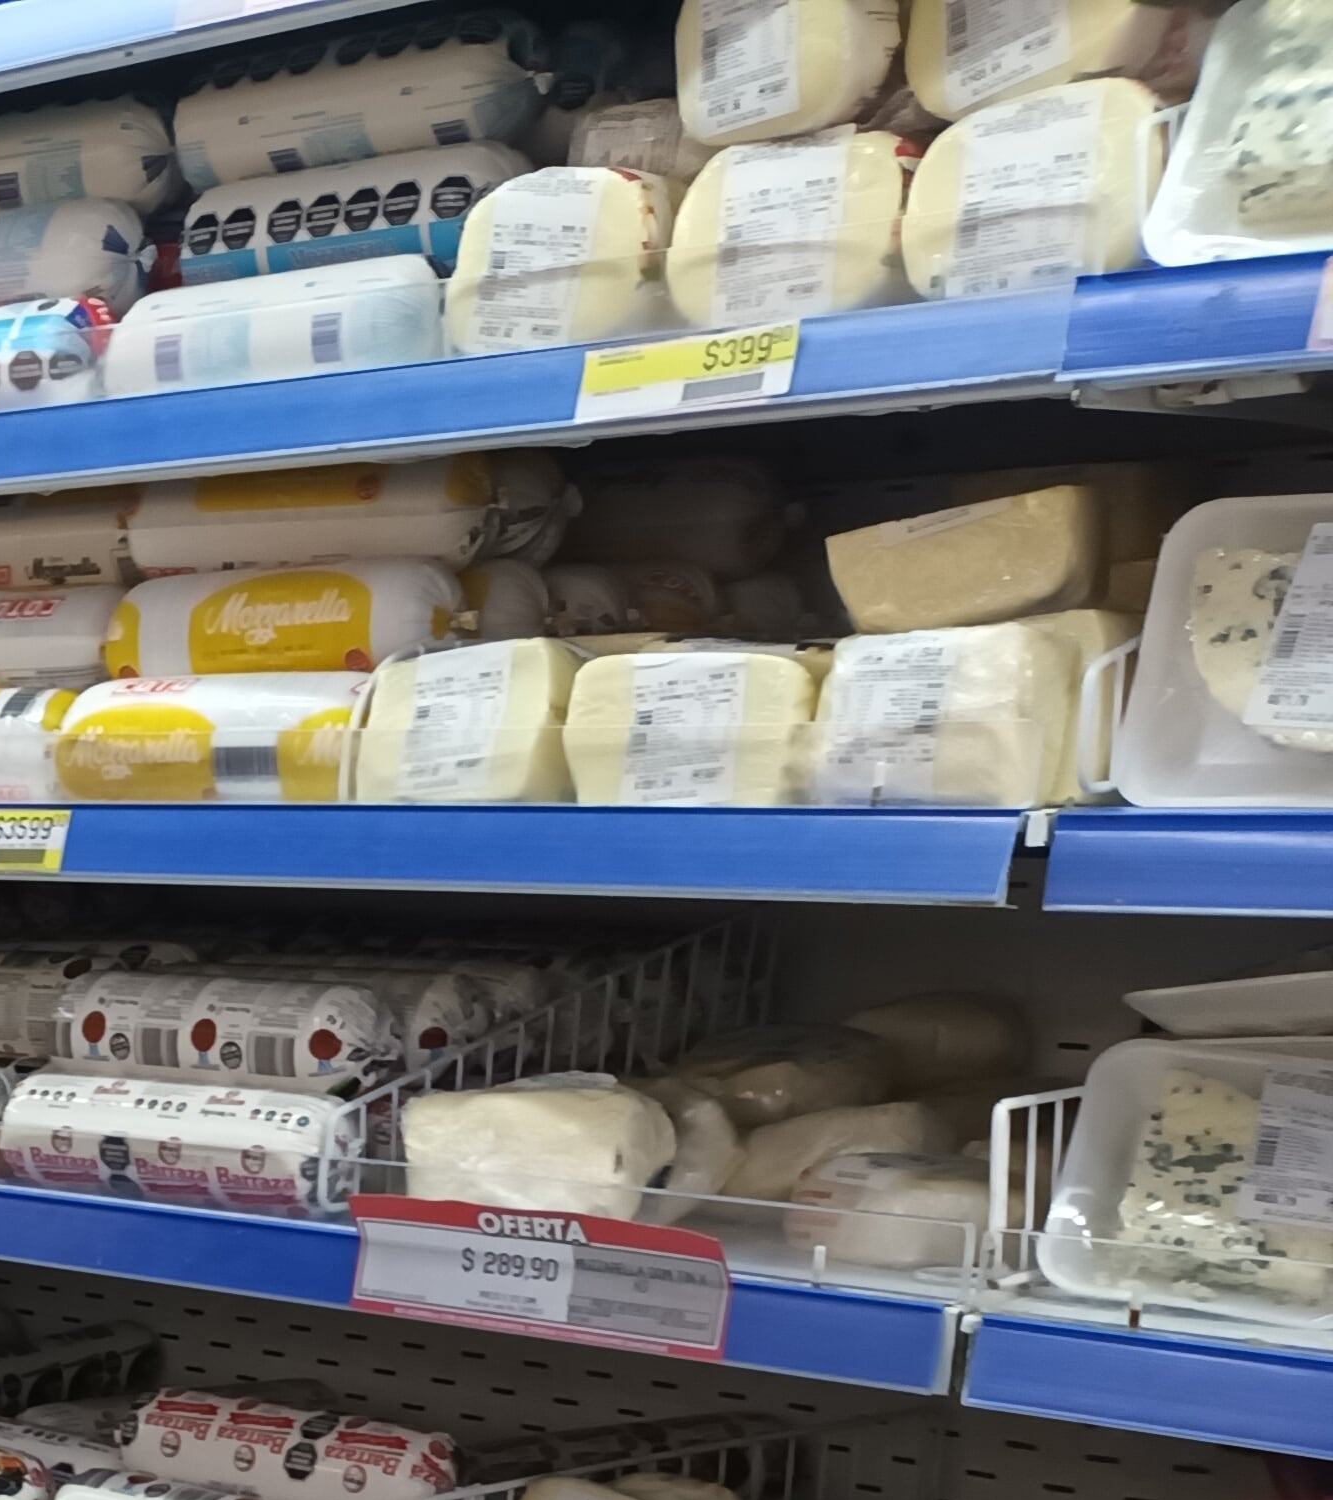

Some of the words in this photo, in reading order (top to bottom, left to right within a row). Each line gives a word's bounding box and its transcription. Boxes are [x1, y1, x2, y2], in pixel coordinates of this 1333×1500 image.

[29, 1147, 99, 1171] Barraza
[134, 1157, 210, 1184] Barraza
[215, 1166, 297, 1191] Barraza
[477, 1212, 588, 1245] OFERTA
[144, 1412, 212, 1441] Barraza
[217, 1424, 288, 1455] Barraza
[324, 1444, 402, 1476] Barraza
